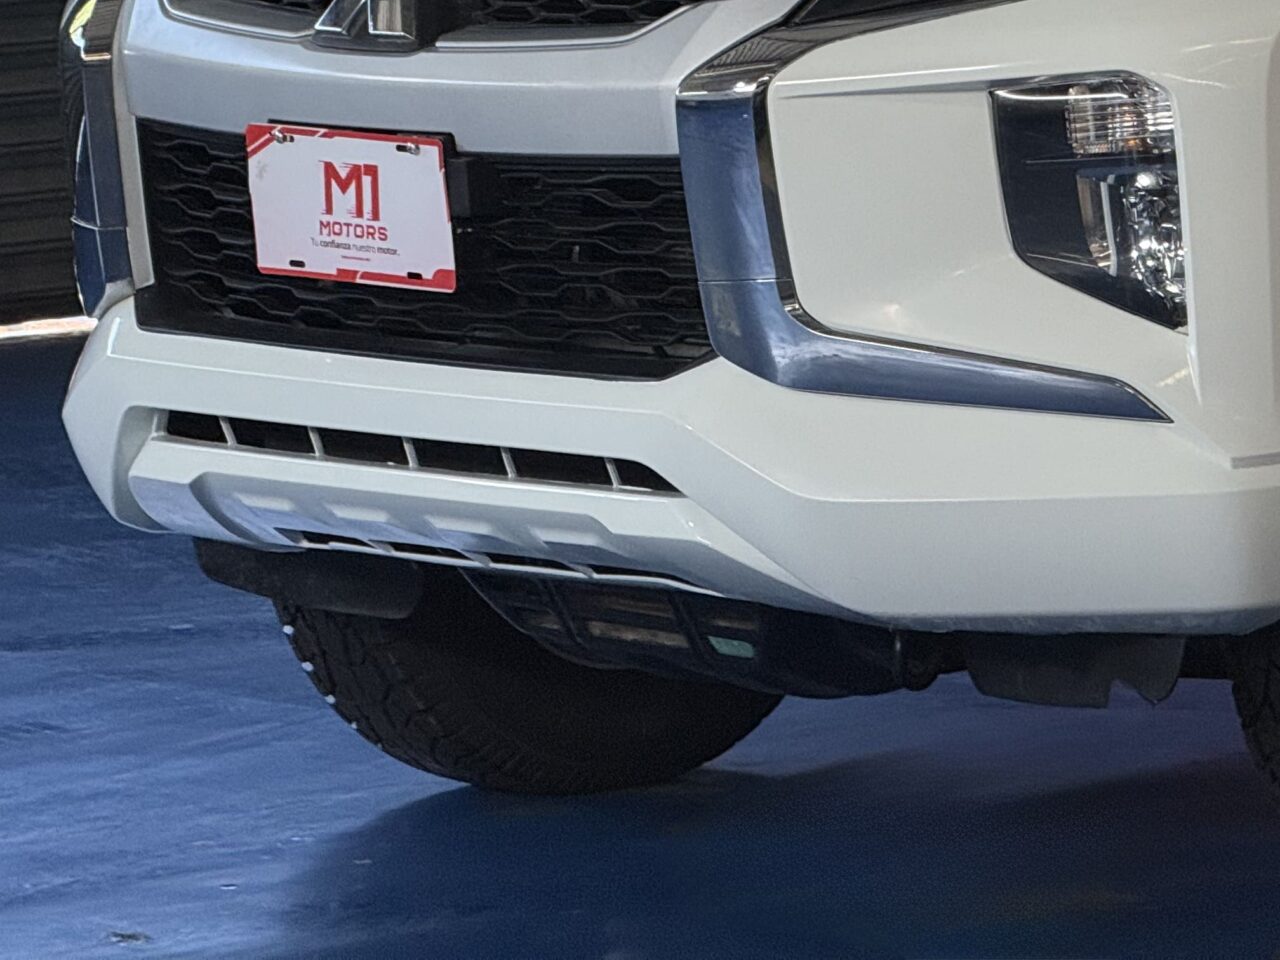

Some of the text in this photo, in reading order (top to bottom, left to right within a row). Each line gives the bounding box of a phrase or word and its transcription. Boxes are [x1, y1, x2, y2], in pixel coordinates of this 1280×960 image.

[319, 160, 381, 222] M1
[319, 220, 388, 242] MOTORS
[320, 239, 352, 250] confianza
